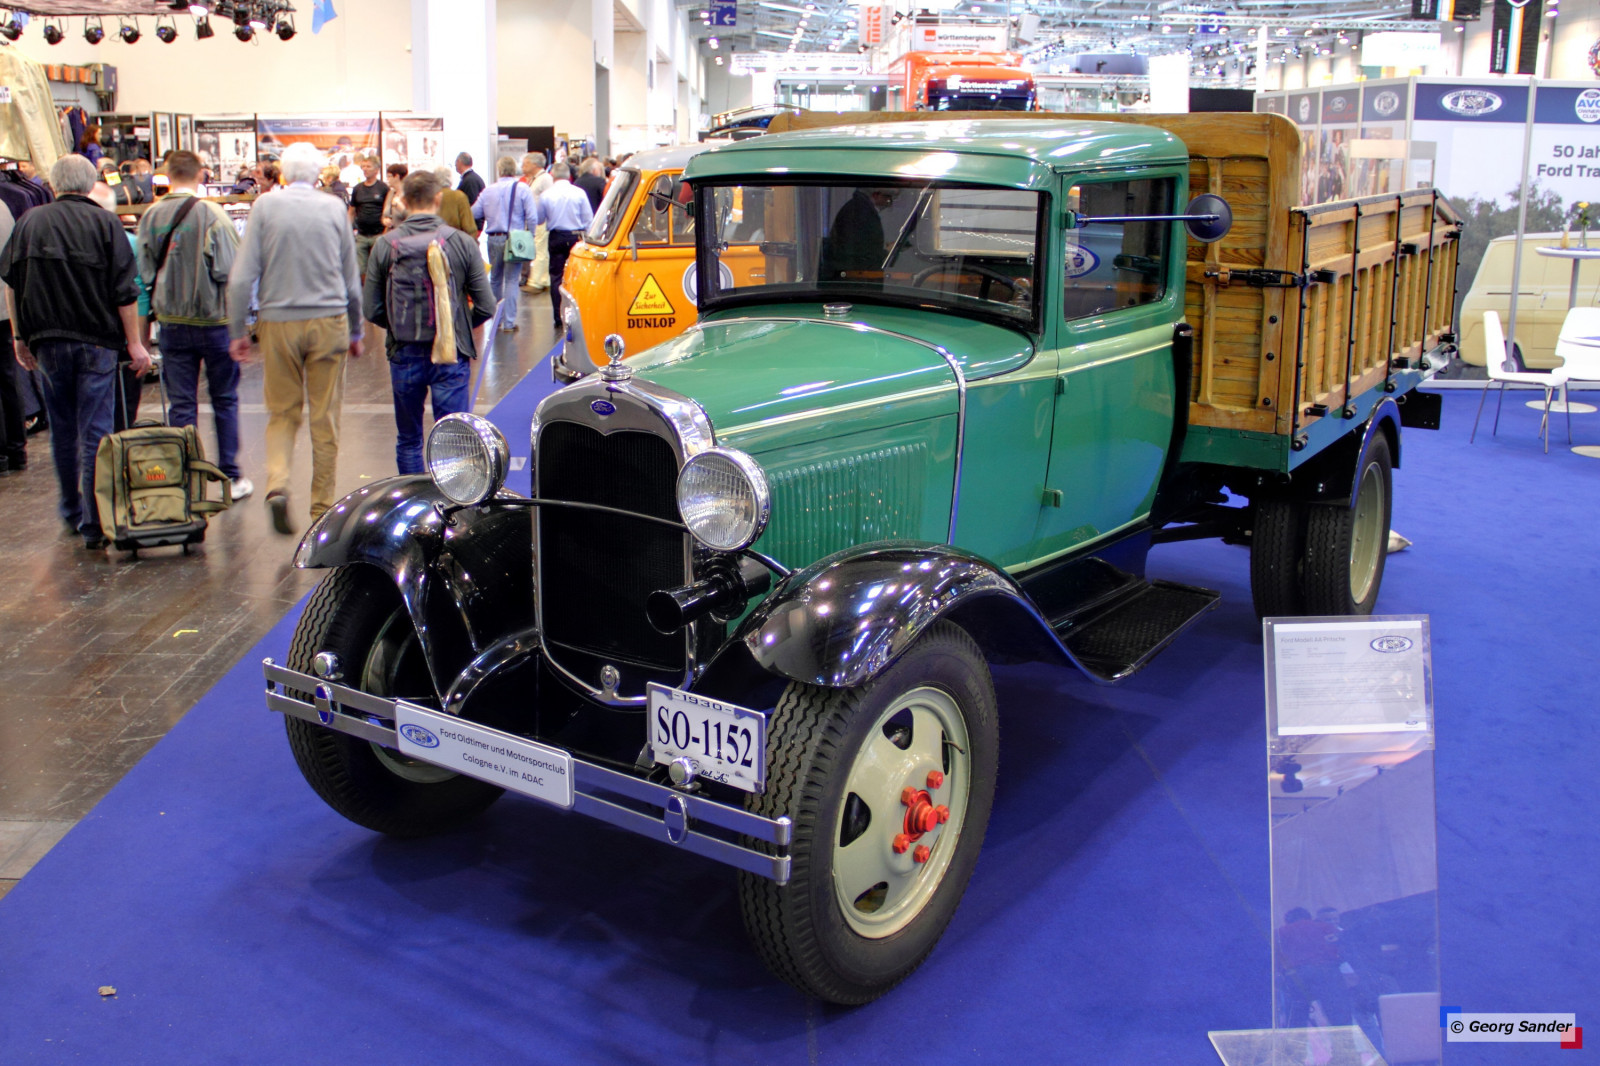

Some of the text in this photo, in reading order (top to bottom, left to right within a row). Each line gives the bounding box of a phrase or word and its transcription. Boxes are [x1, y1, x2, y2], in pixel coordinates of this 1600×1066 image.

[710, 12, 716, 24] 1
[938, 32, 996, 42] württembergische
[1553, 144, 1574, 158] 50
[1537, 164, 1573, 177] Ford
[644, 292, 656, 300] Zur
[634, 302, 666, 310] Sicherheit
[627, 317, 676, 328] DUNLOP
[658, 706, 753, 768] SO-1152
[440, 728, 456, 740] Ford
[457, 734, 489, 750] Oldtimer
[491, 745, 505, 755] und
[506, 749, 565, 775] Motorsportclub
[462, 753, 544, 786] Cologne e.V. im ADAC
